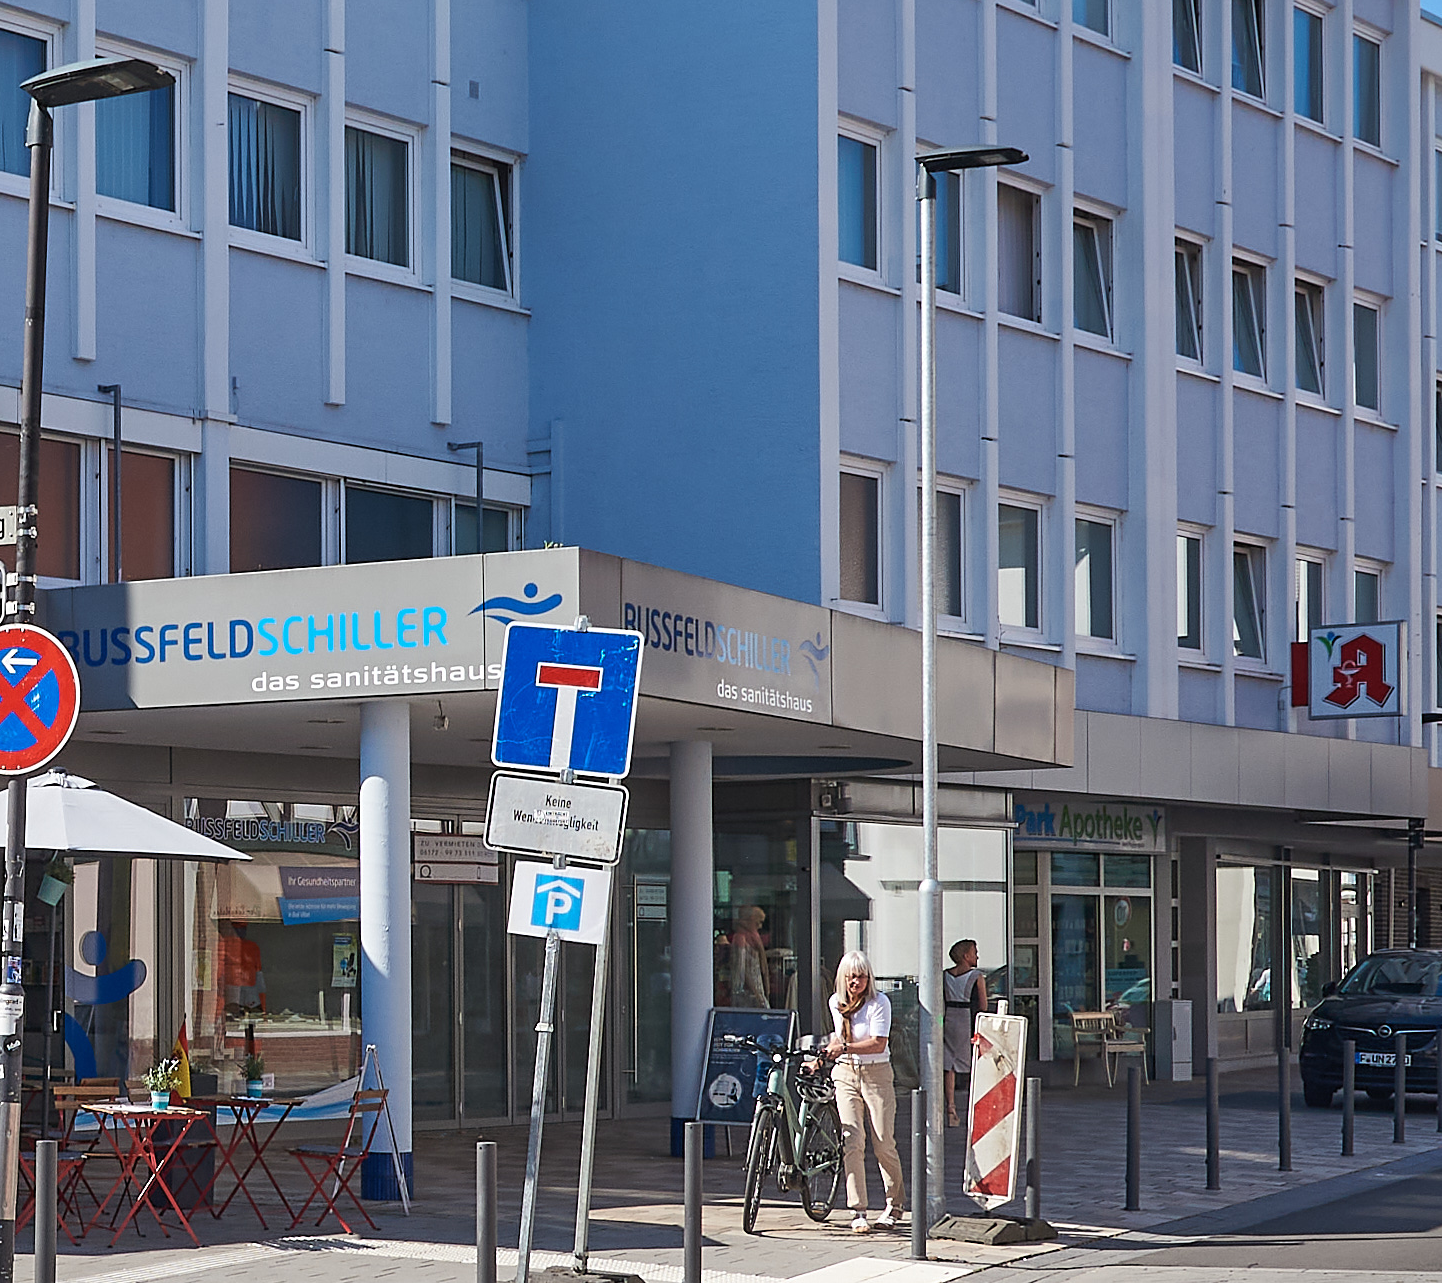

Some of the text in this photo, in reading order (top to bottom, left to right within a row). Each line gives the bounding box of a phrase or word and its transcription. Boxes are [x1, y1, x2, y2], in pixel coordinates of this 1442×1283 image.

[58, 606, 449, 668] BUSSFELDSCHILLER
[625, 602, 791, 676] BUSSFELDSCHILLER
[251, 661, 502, 692] das sanitätshaus
[717, 678, 813, 713] das sanitätshaus
[545, 794, 572, 809] Keine
[1016, 803, 1143, 846] Park Apotheke
[435, 840, 475, 848] VERMIETEN
[288, 876, 357, 888] Ihr Gesundheitspartner
[545, 891, 573, 925] P
[1360, 1054, 1384, 1064] F UN
